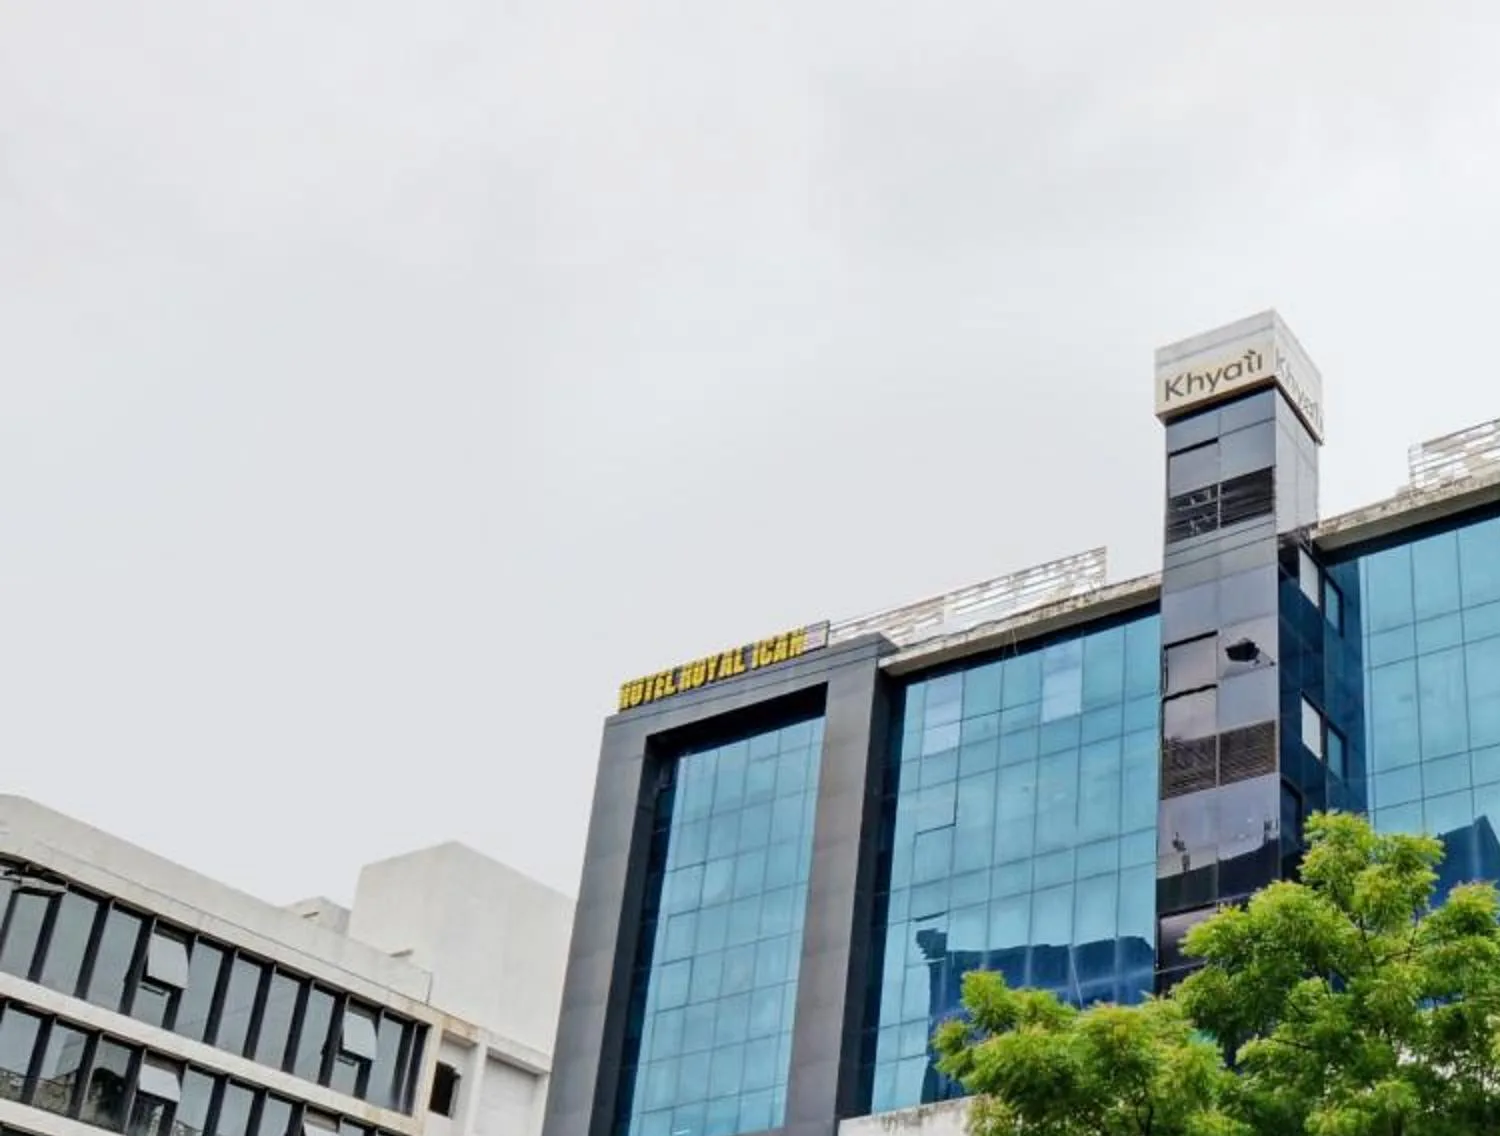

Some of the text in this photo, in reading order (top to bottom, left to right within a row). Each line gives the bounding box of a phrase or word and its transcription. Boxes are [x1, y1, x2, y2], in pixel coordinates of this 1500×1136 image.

[1164, 348, 1264, 402] Khyati
[618, 667, 678, 711] HOTEL
[678, 645, 747, 691] ROYAL
